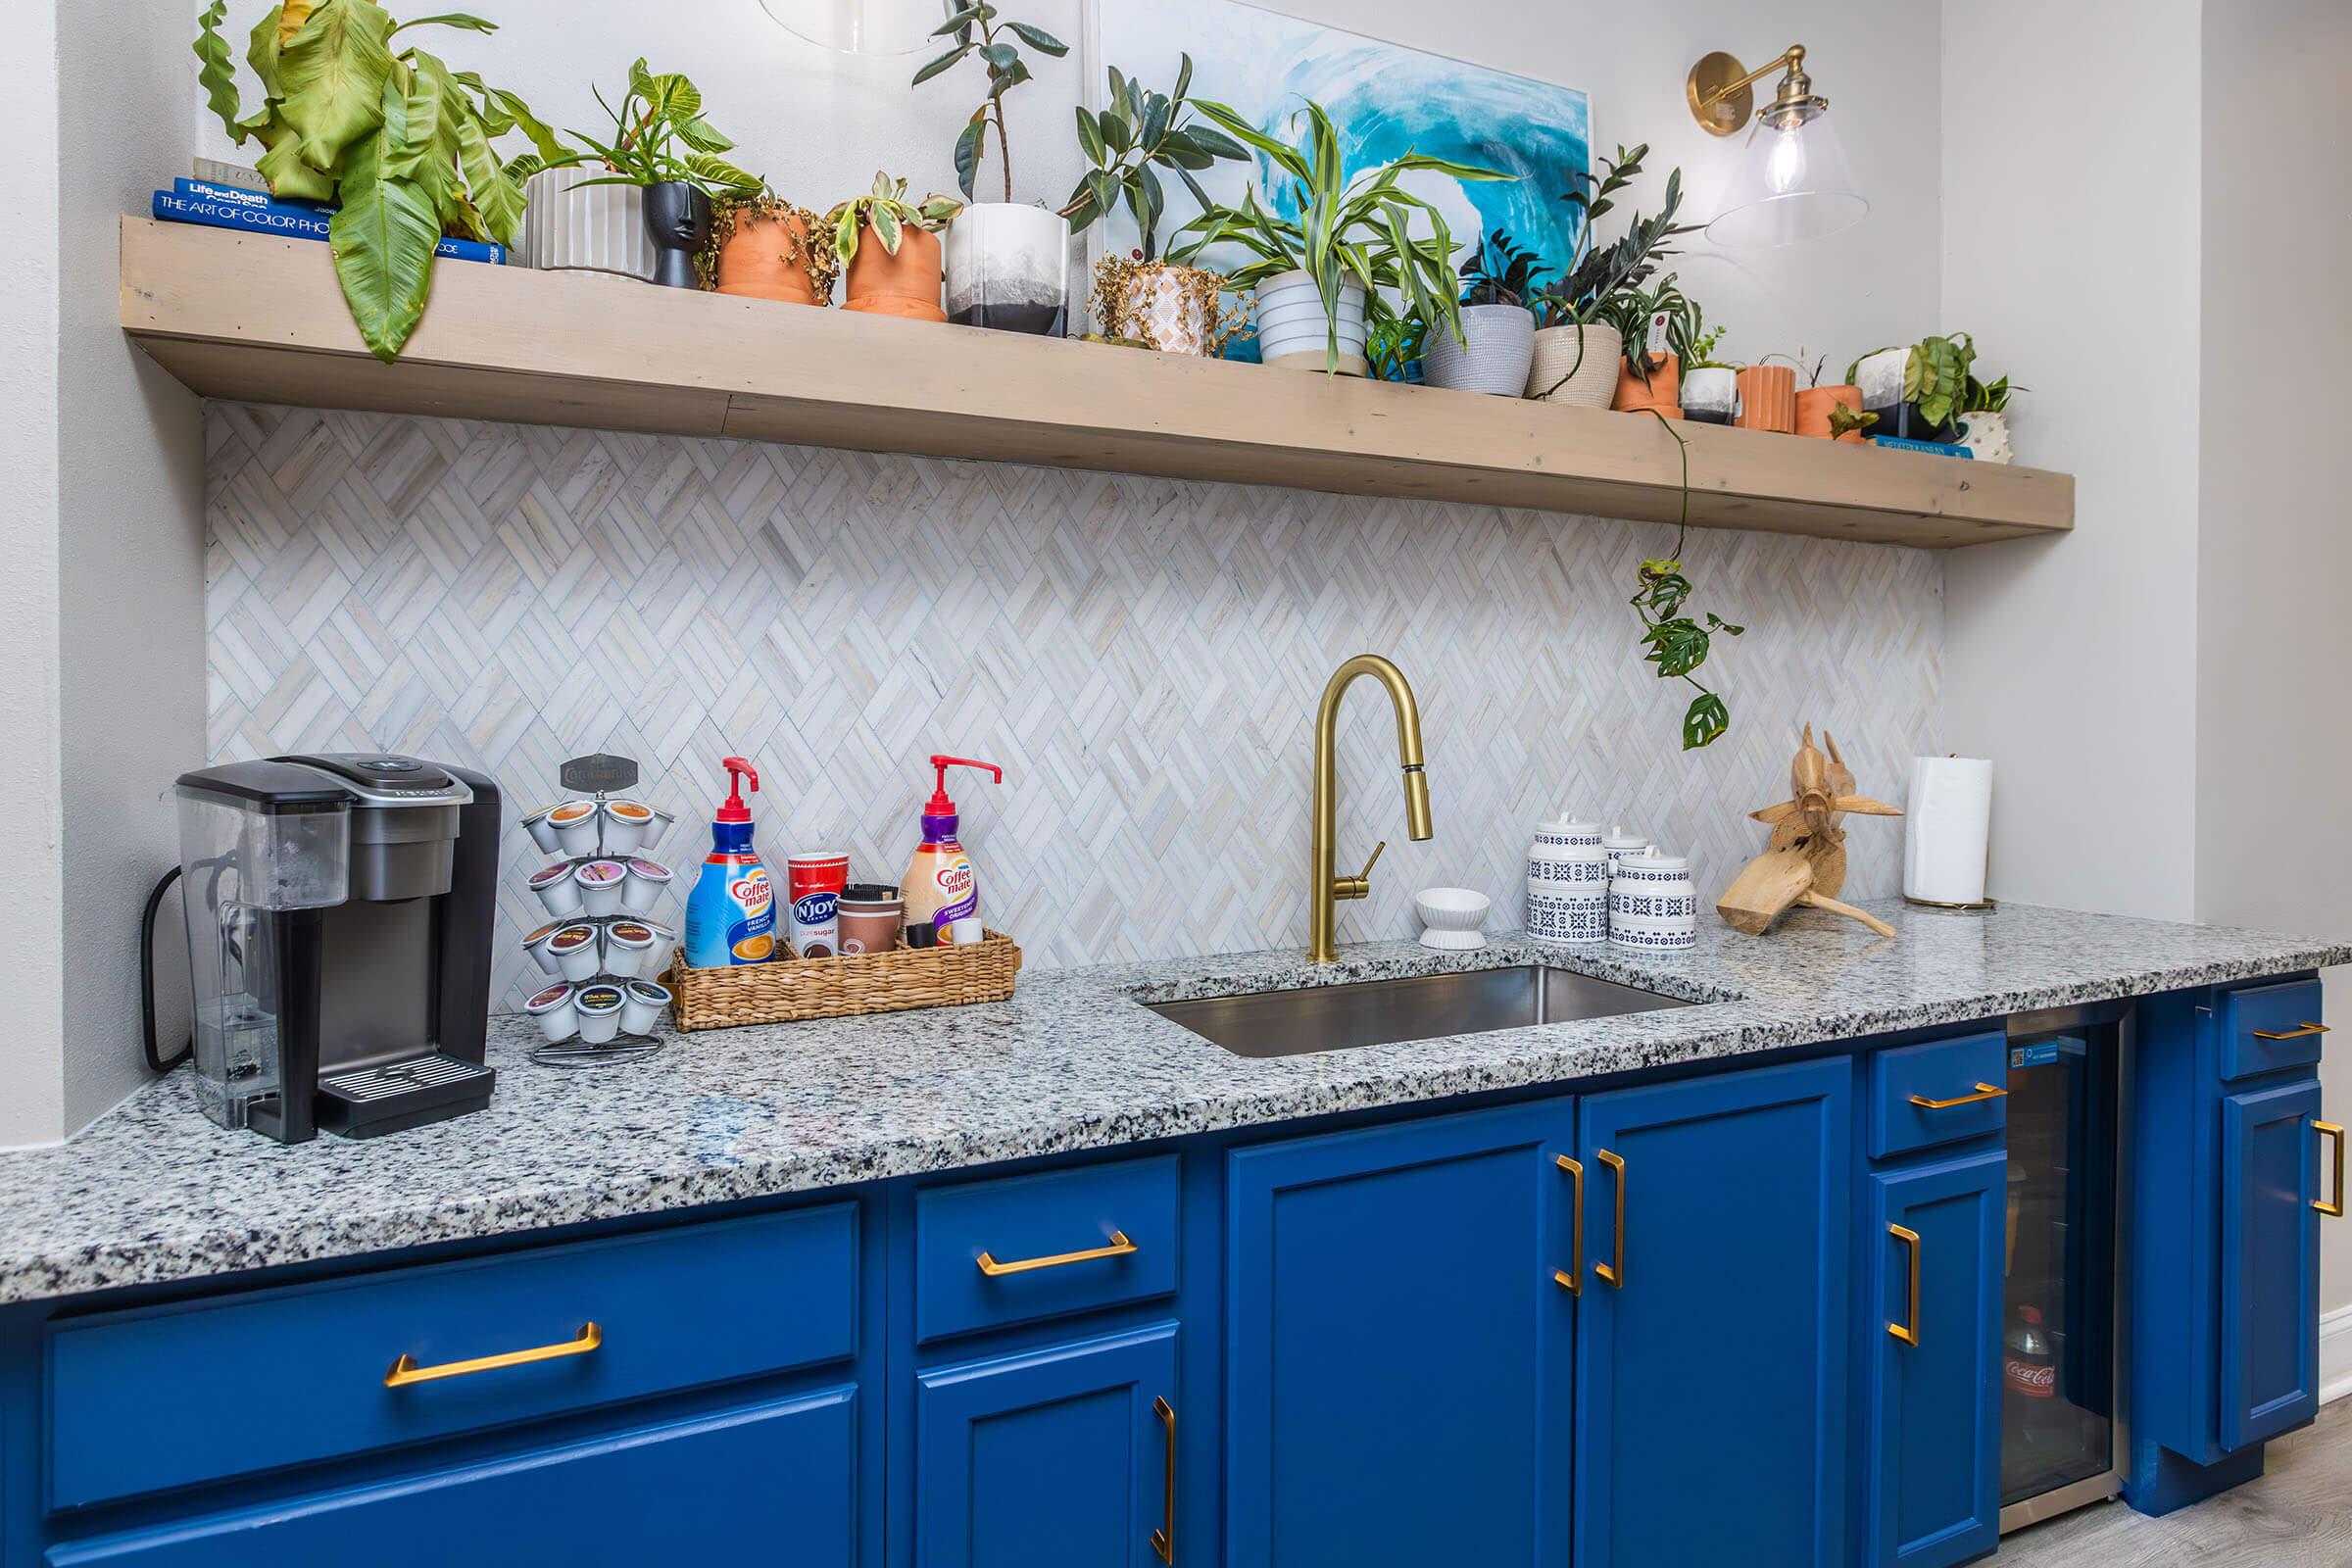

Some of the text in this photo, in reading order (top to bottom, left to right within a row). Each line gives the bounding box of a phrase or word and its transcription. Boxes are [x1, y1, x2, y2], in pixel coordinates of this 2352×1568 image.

[190, 183, 213, 195] Life
[230, 190, 268, 204] Death
[161, 196, 187, 212] THE
[189, 202, 217, 217] ART
[219, 207, 241, 220] OF
[243, 210, 295, 229] COLOR
[298, 219, 330, 234] PHO
[937, 869, 971, 886] Coffee
[947, 879, 971, 894] mate
[732, 881, 769, 900] Coffee
[745, 892, 769, 907] mate
